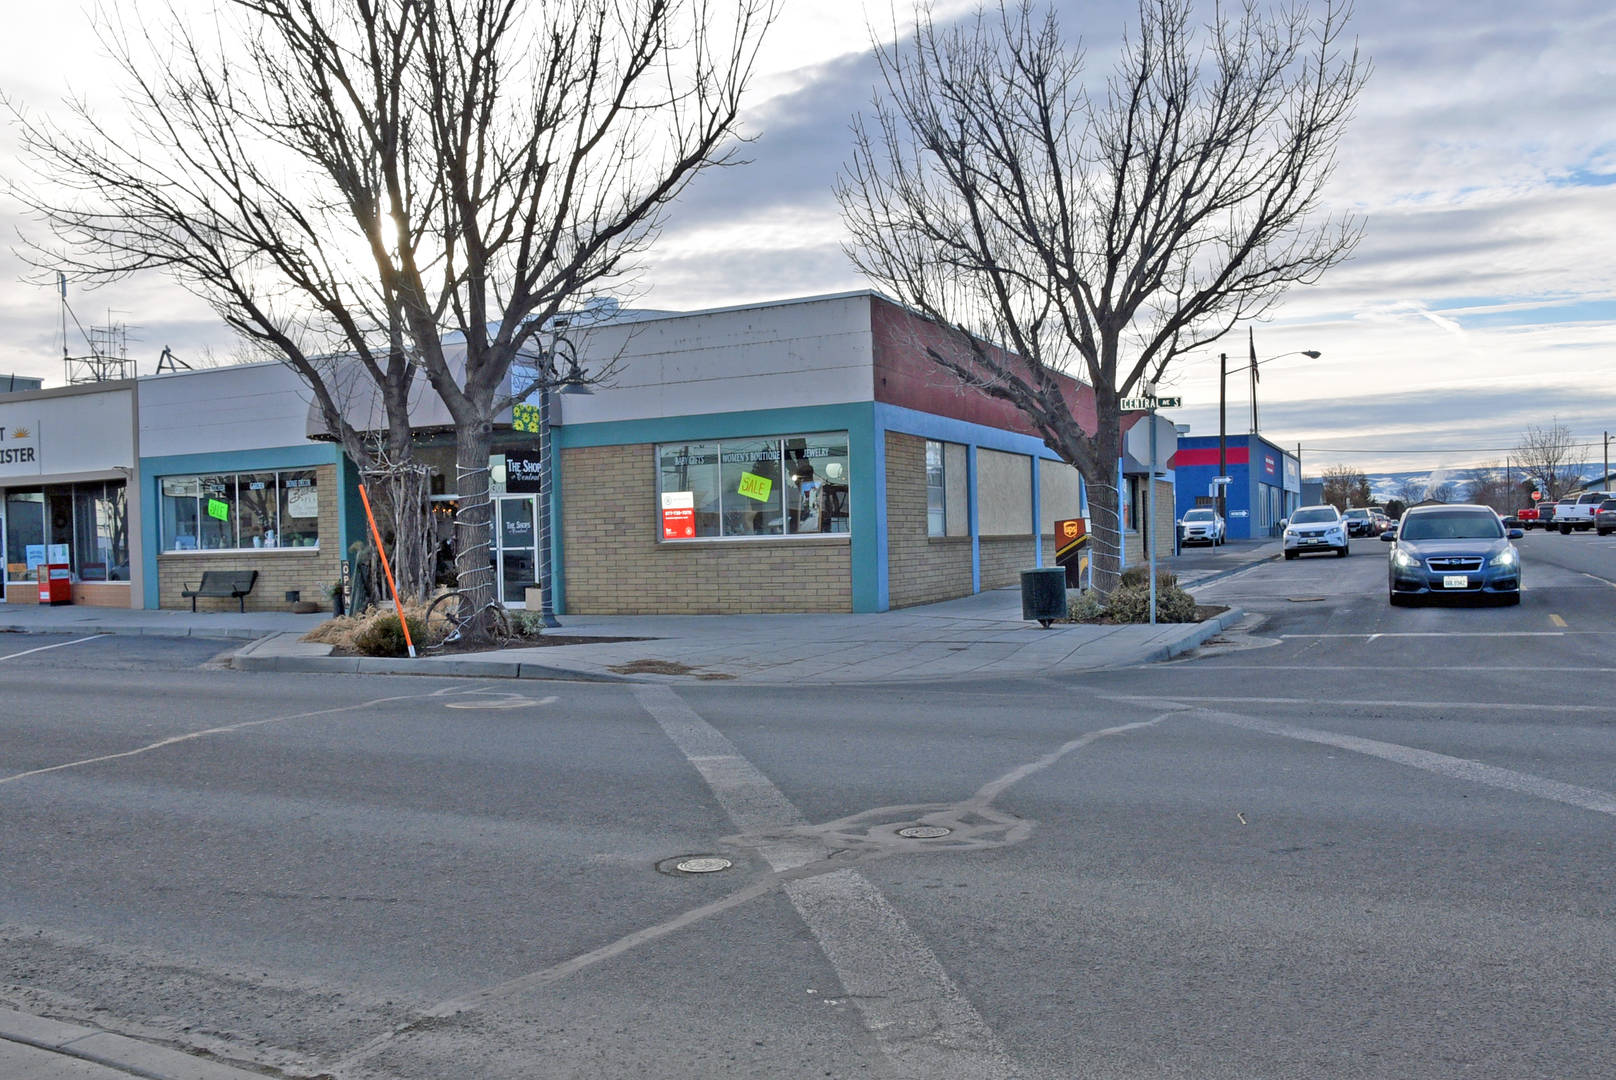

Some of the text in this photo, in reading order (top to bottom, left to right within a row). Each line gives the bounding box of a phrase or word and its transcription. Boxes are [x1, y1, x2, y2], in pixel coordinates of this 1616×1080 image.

[1123, 398, 1159, 409] CENTRAL
[722, 450, 781, 463] WOMEN'S BOUTIQUE
[803, 447, 830, 458] JEWELRY
[507, 459, 541, 472] THE SHOP
[742, 478, 765, 496] SALE
